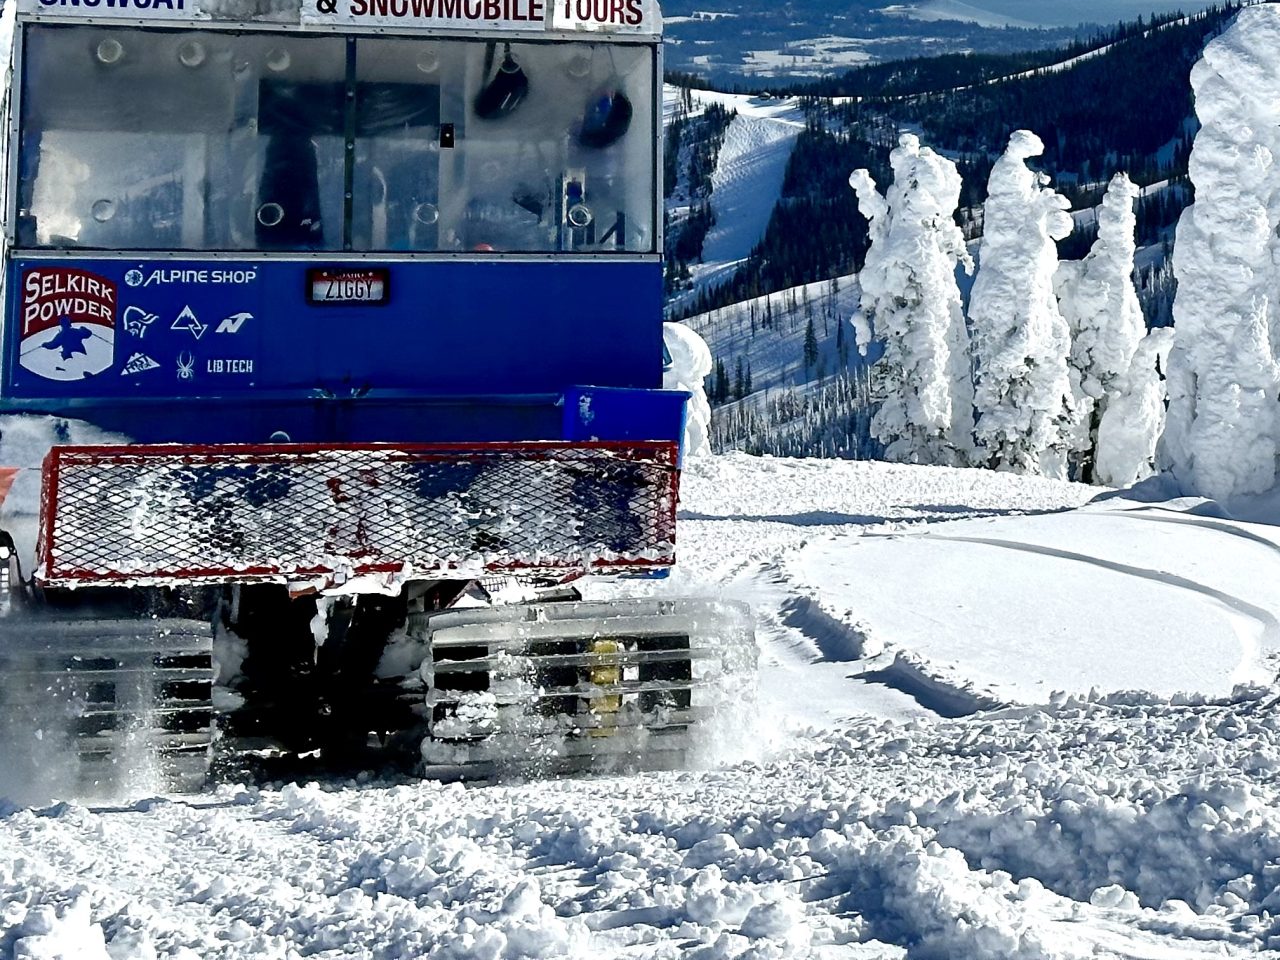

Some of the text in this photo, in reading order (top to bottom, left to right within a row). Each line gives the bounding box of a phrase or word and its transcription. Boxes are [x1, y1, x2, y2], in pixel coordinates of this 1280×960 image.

[25, 272, 114, 303] SELKIRK
[143, 269, 256, 287] ALPINE SHOP
[325, 280, 373, 299] ZIGGY
[24, 298, 112, 335] POWDER
[207, 359, 253, 373] LIB TECH
